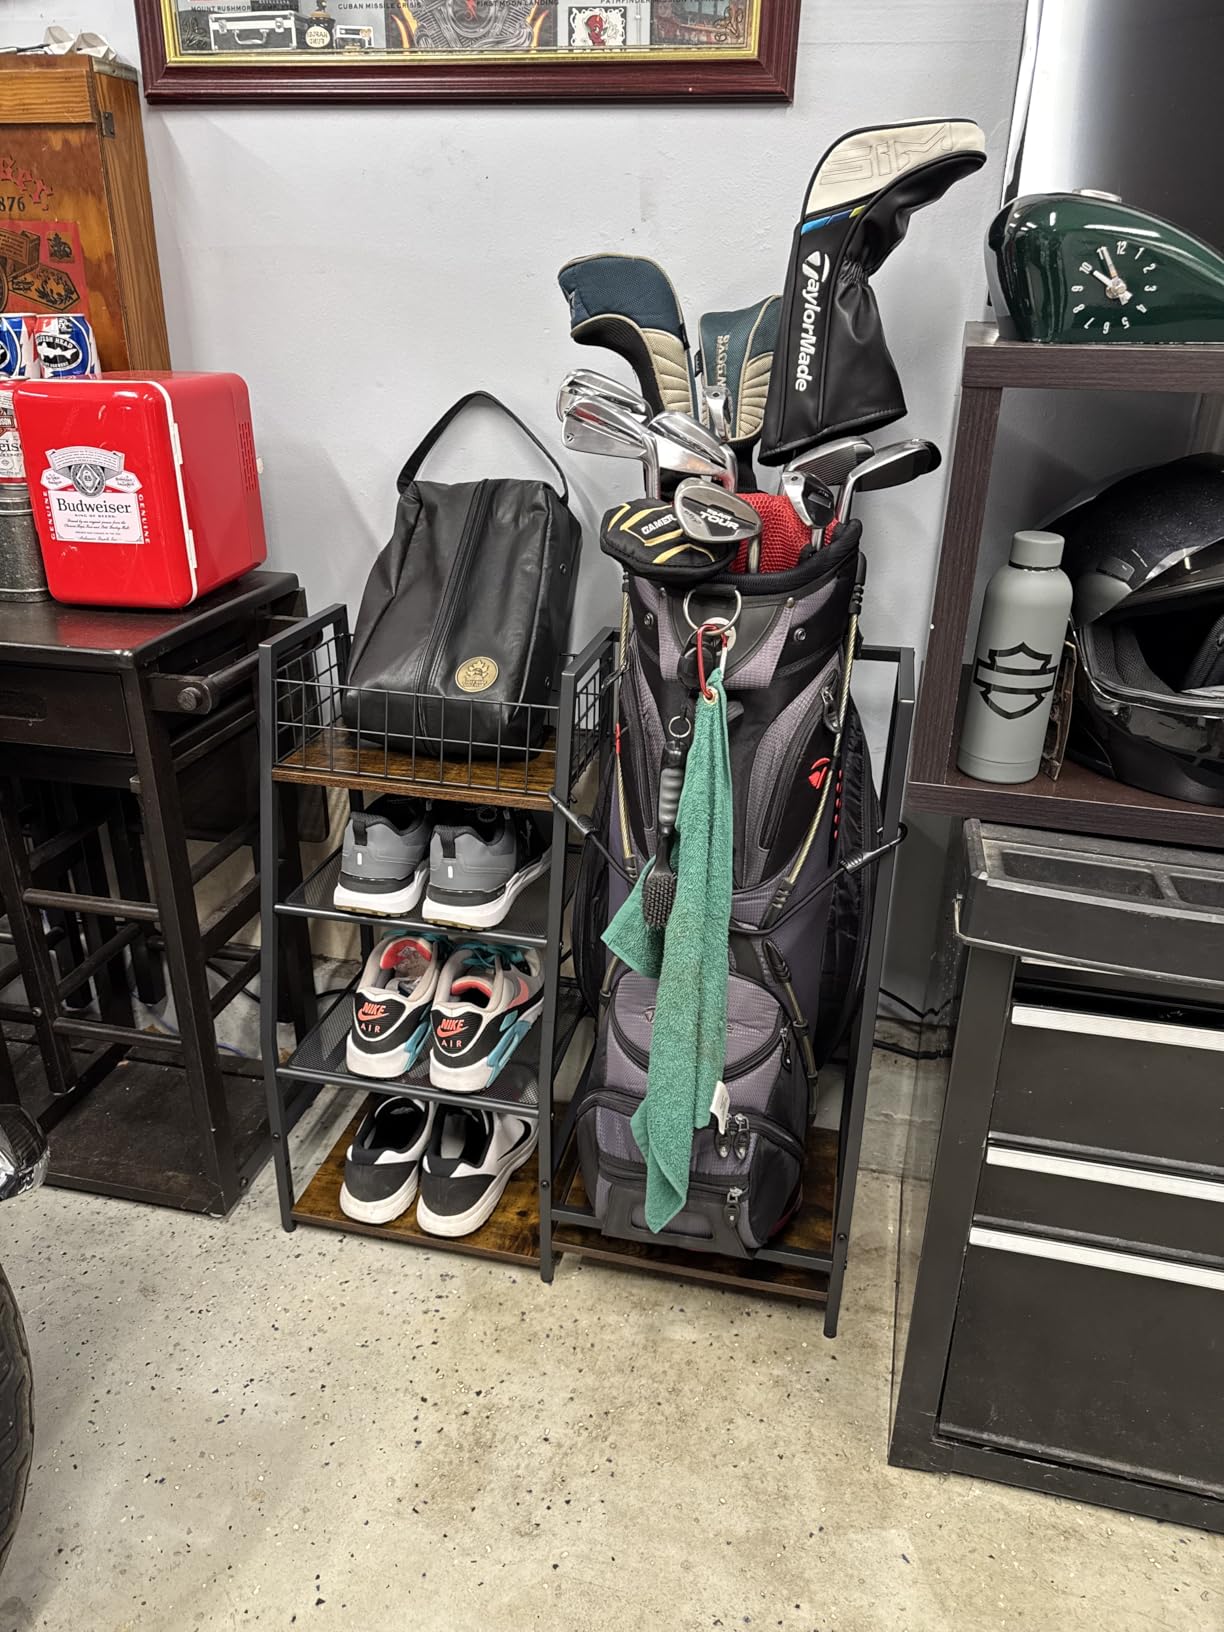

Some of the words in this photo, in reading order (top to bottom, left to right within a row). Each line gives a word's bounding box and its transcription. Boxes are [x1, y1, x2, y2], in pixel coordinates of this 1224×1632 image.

[1116, 240, 1128, 255] 12
[1134, 247, 1145, 260] 1
[1079, 261, 1093, 274] 10
[1142, 263, 1157, 274] 2
[1072, 303, 1085, 314] 8
[1136, 303, 1147, 314] 4
[795, 250, 831, 392] TaylorMade
[1083, 317, 1095, 330] 7
[1121, 316, 1130, 330] 5
[1102, 321, 1110, 335] 6
[56, 497, 131, 513] Budweiser
[138, 493, 151, 544] GENUINE
[641, 513, 677, 535] GAMER
[700, 511, 740, 530] TOUR
[362, 1001, 386, 1016] NIKE
[360, 1023, 381, 1033] AIR
[440, 1018, 465, 1031] NIKE
[441, 1039, 462, 1048] AIR
